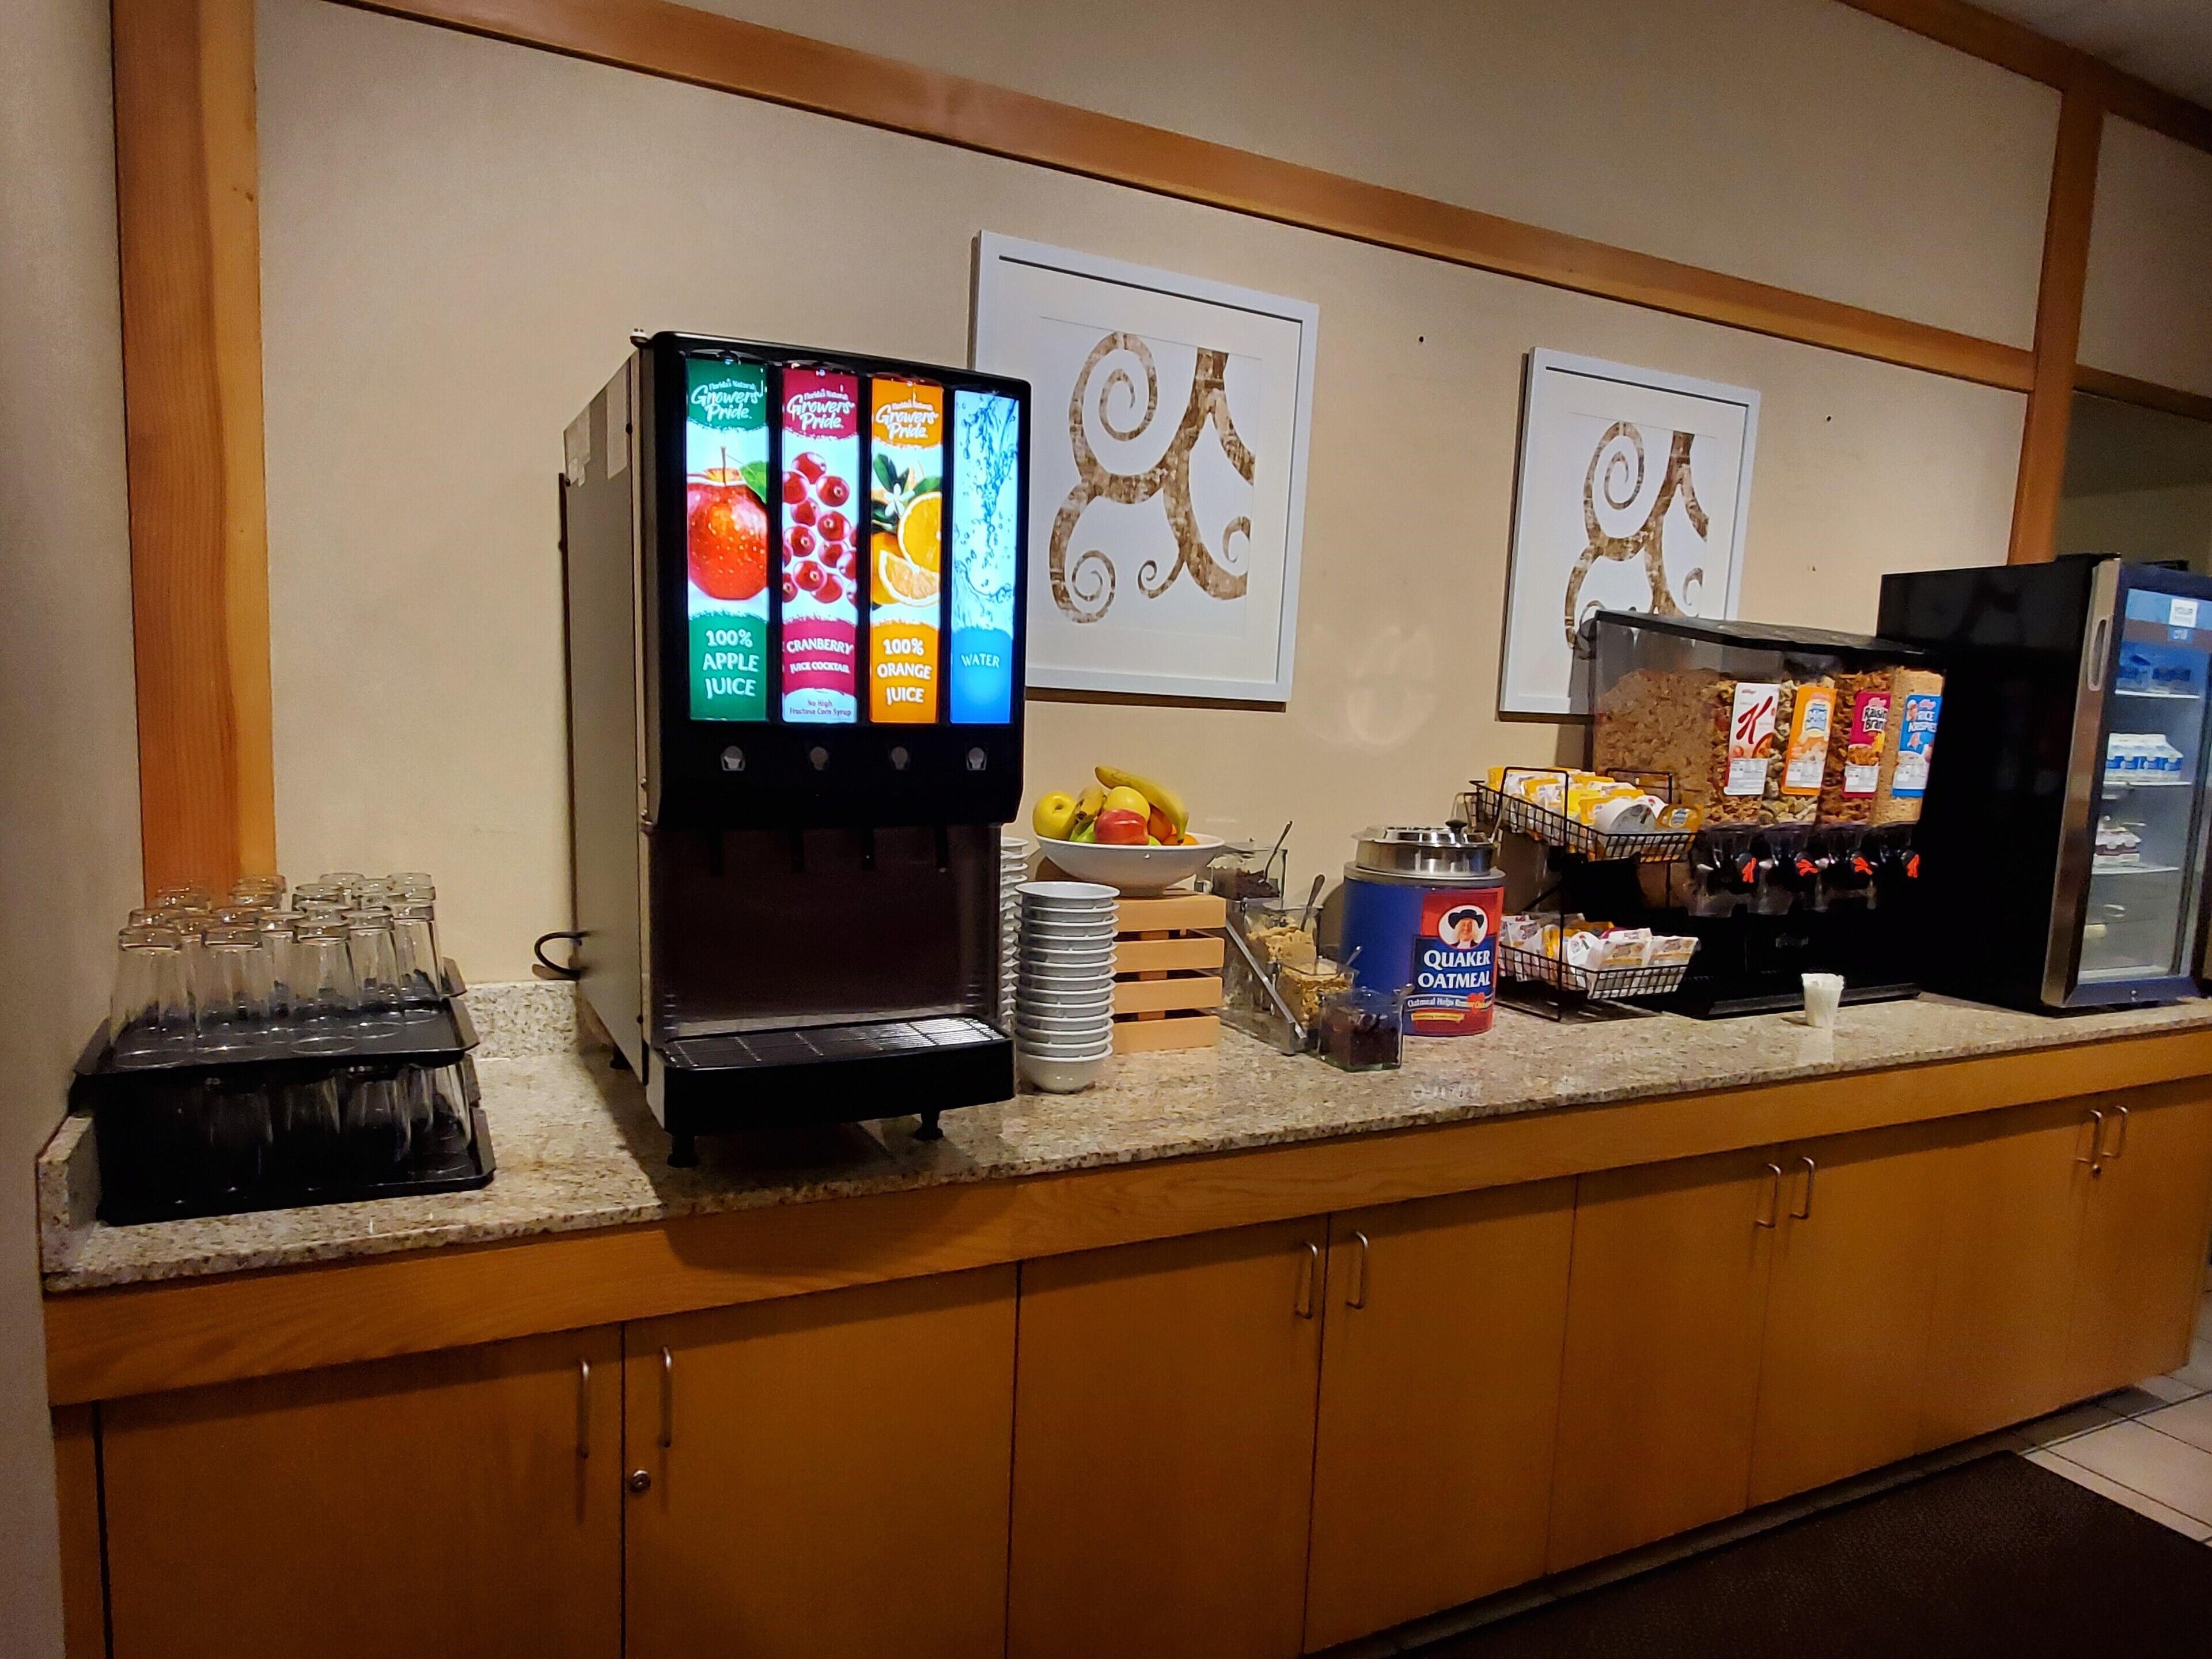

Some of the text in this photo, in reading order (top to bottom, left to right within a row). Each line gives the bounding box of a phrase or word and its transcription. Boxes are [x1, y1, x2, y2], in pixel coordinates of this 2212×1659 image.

[706, 628, 753, 648] 100%
[786, 638, 854, 655] CRANBERRY
[883, 638, 925, 656] 100%
[703, 652, 759, 673] APPLE
[790, 661, 851, 674] JUICE COCKTAIL
[960, 653, 1000, 668] WATER
[877, 662, 932, 680] ORANGE
[705, 677, 756, 699] JUICE
[886, 687, 925, 706] JUICE
[817, 700, 832, 709] High
[833, 708, 851, 717] Syrup
[1424, 949, 1491, 971] QUAKER
[1418, 971, 1491, 988] OATMEAL
